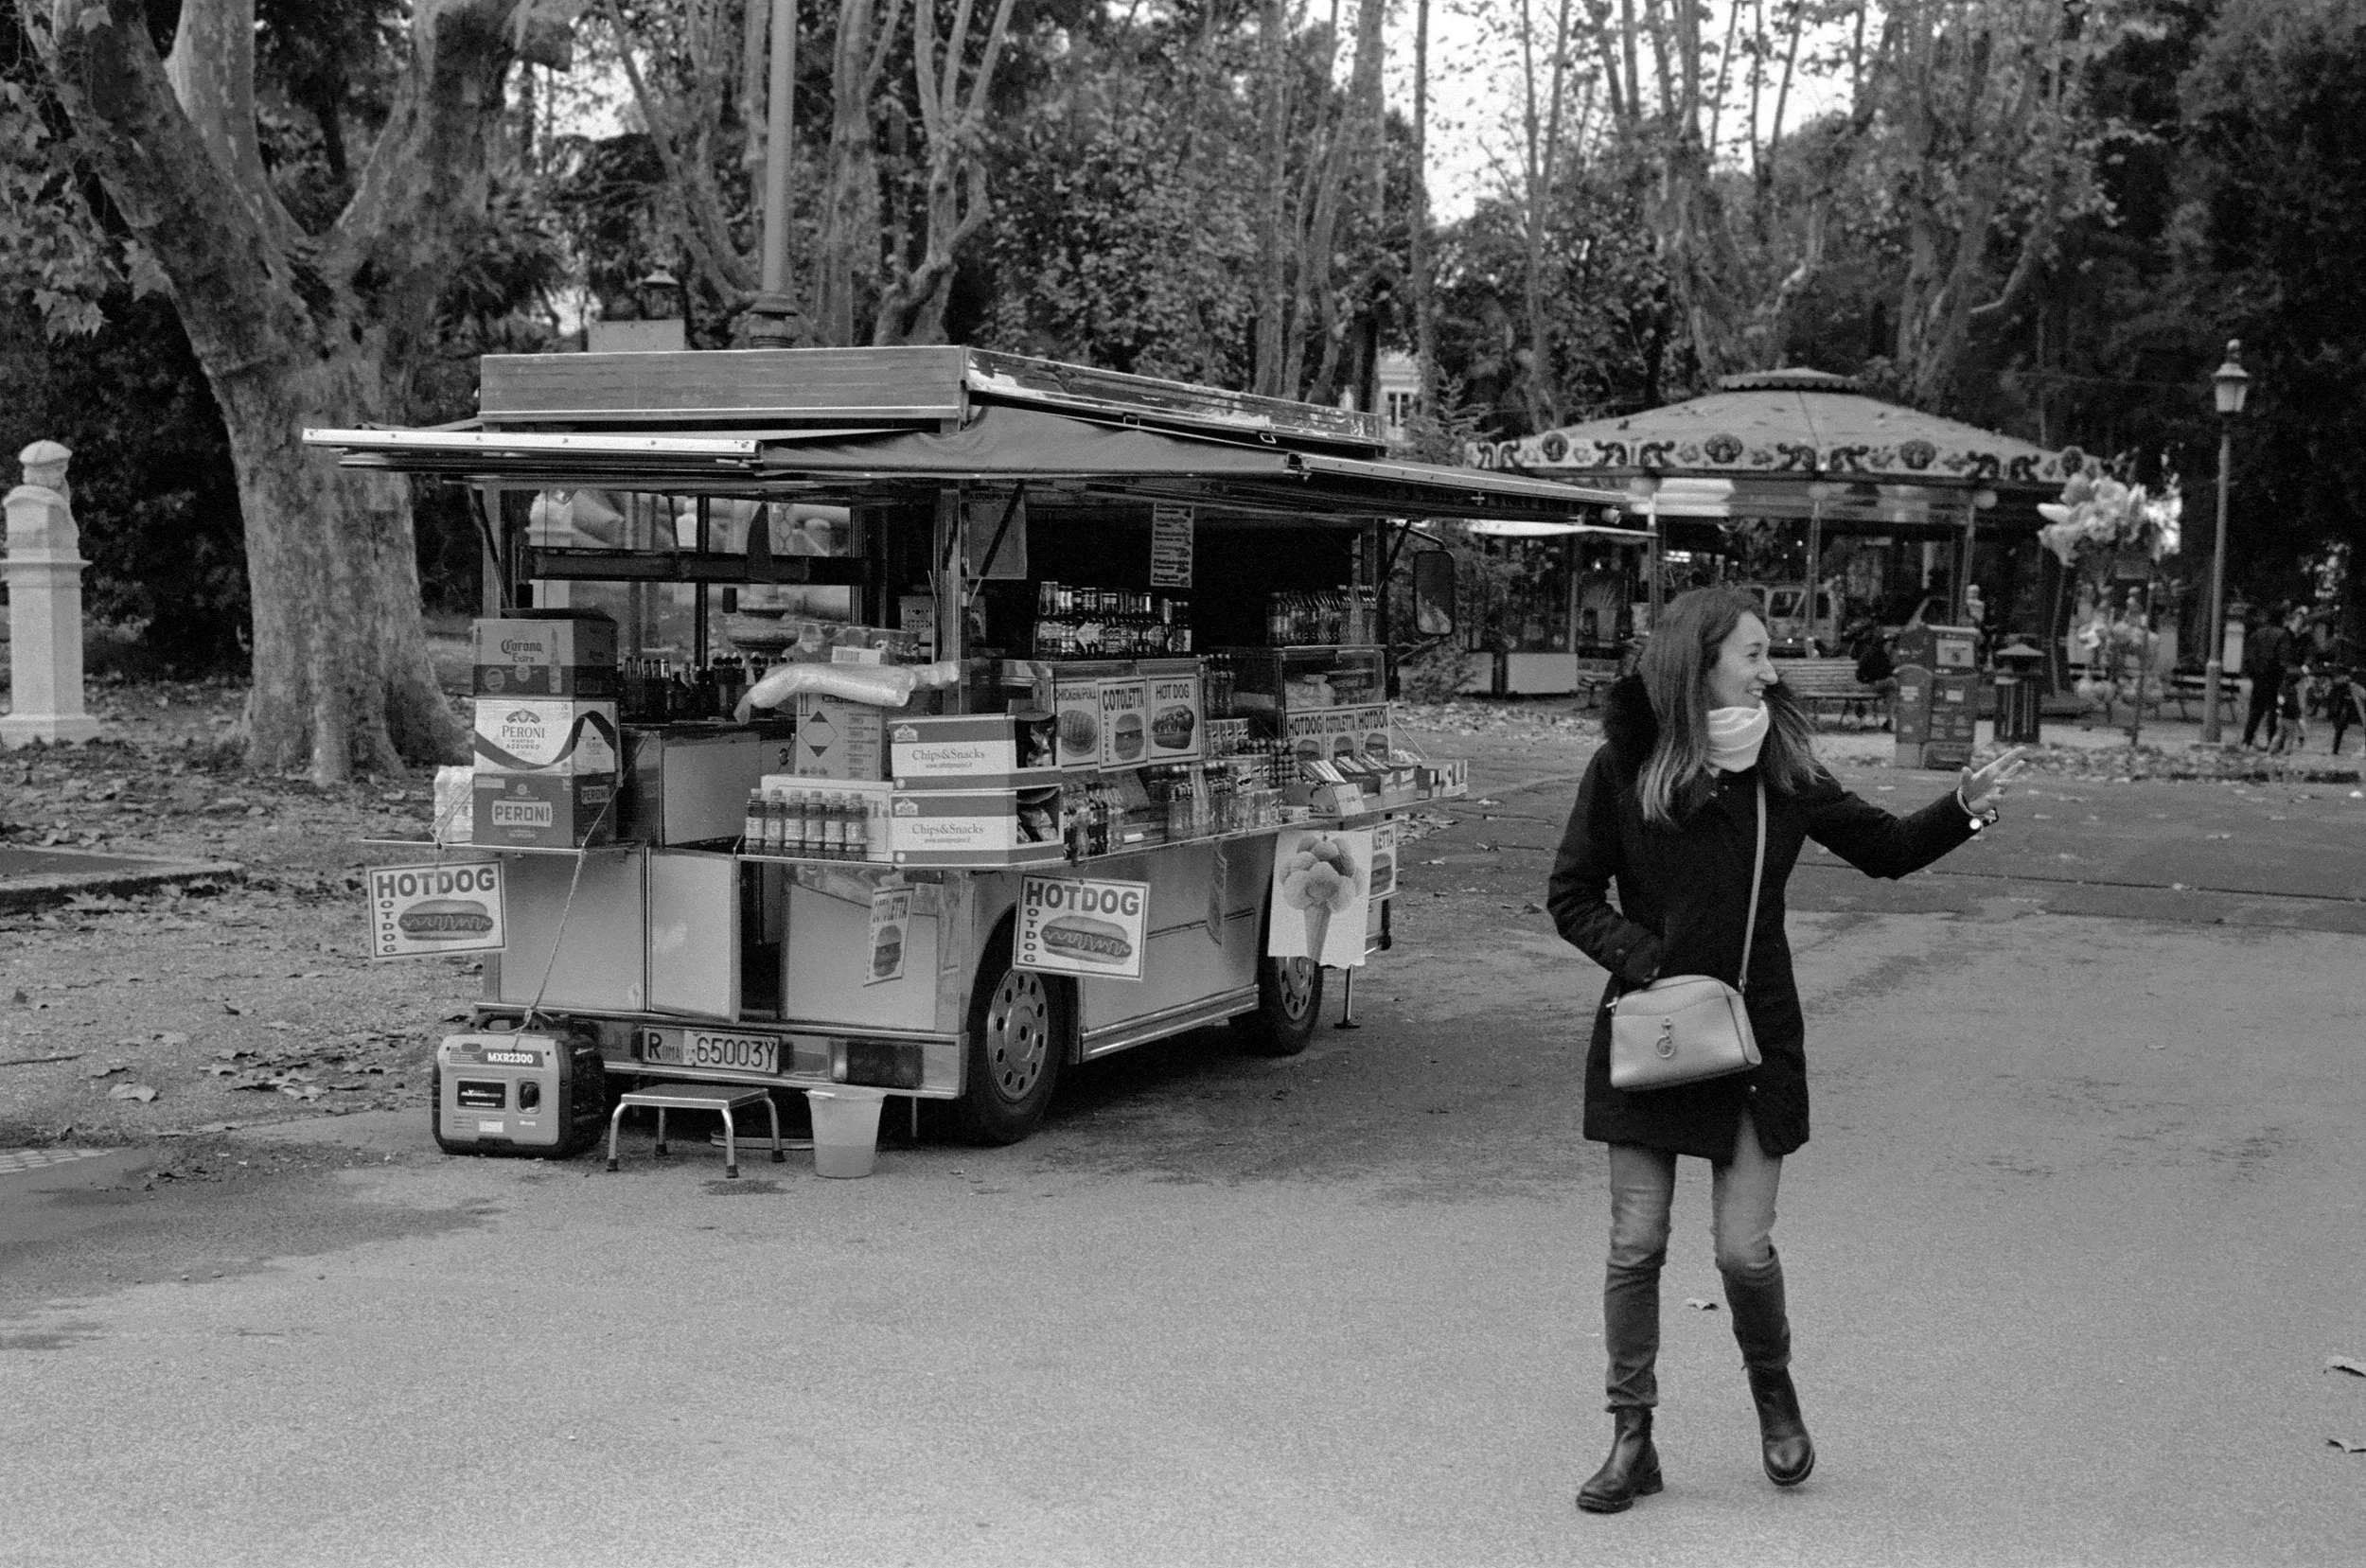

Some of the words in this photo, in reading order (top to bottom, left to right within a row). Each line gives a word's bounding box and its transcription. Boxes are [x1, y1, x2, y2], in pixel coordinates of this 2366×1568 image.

[501, 639, 544, 655] Corona
[512, 653, 535, 662] Extra
[1102, 686, 1145, 712] COTOLETTA
[1156, 684, 1173, 700] HOT
[1173, 683, 1190, 699] DOG
[502, 725, 545, 739] PERONI
[1287, 714, 1322, 738] HOTDOG
[582, 788, 610, 802] PERONI
[494, 804, 550, 822] PERONI
[377, 868, 495, 899] HOTDOG
[1025, 881, 1139, 917] HOTDOG
[487, 1051, 534, 1065] MXR2300
[697, 1036, 776, 1069] 65003Y
